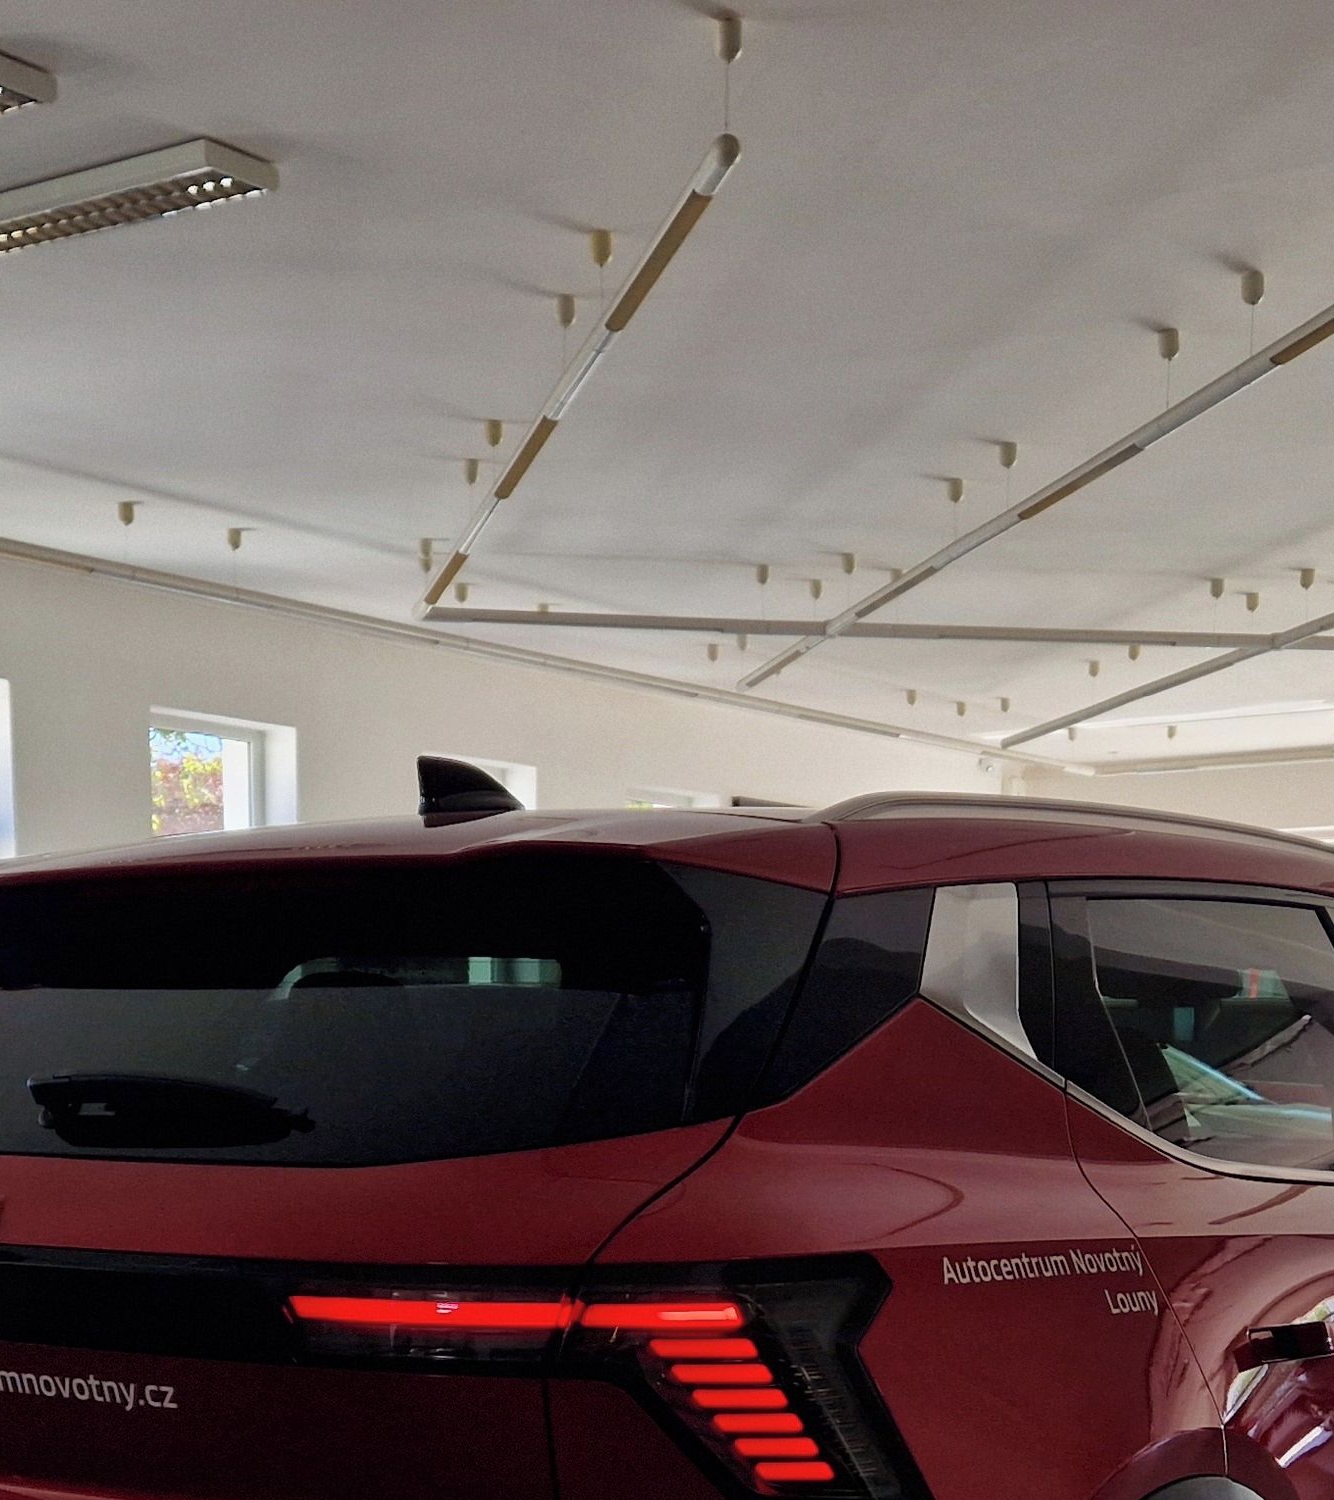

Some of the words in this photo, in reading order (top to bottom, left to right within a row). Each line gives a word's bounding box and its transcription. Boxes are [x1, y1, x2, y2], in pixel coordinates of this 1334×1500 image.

[942, 1252, 1071, 1285] Autocentrum
[1068, 1245, 1144, 1276] Novotný
[1104, 1289, 1159, 1316] Louny
